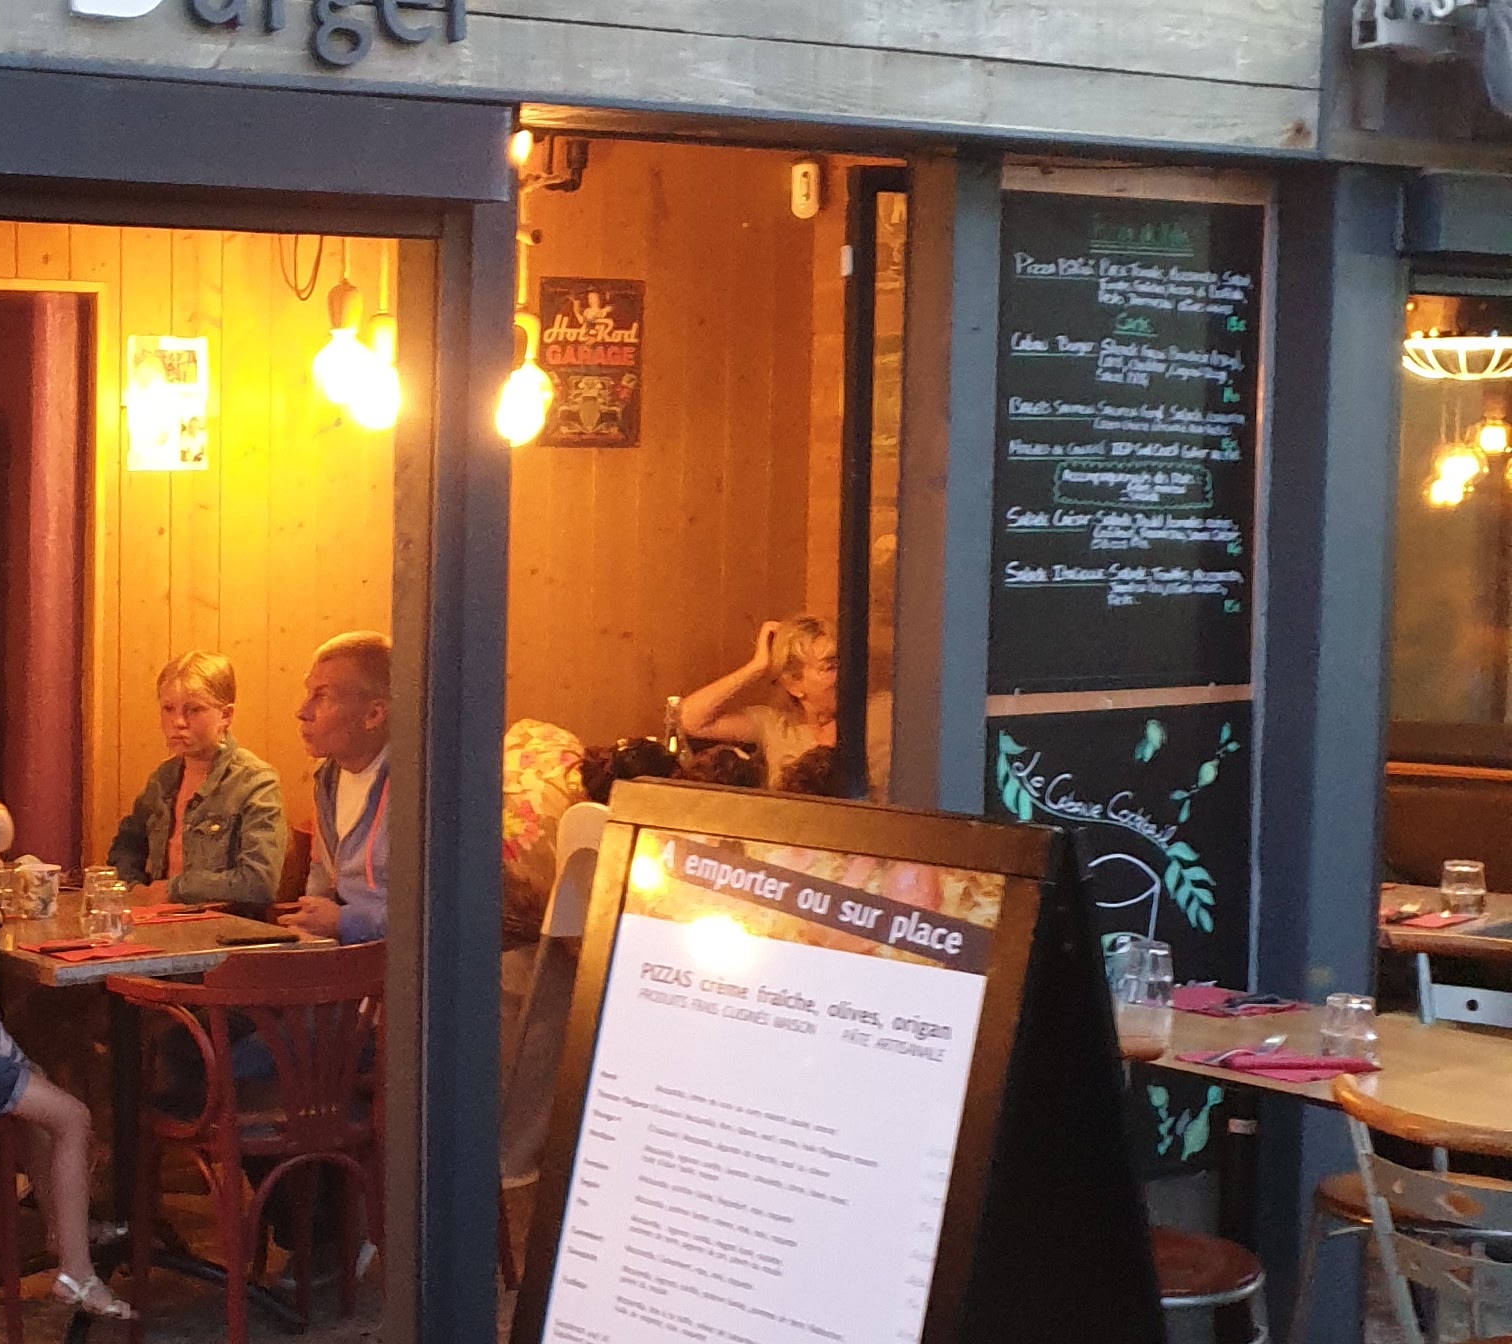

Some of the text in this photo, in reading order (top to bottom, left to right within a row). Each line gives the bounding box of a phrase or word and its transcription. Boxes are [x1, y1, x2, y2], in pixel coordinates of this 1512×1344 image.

[545, 343, 636, 366] GARAGE
[684, 853, 790, 902] emporter
[796, 887, 831, 914] ou
[838, 899, 884, 929] sur
[888, 911, 964, 955] place
[641, 962, 694, 988] PIZZAS
